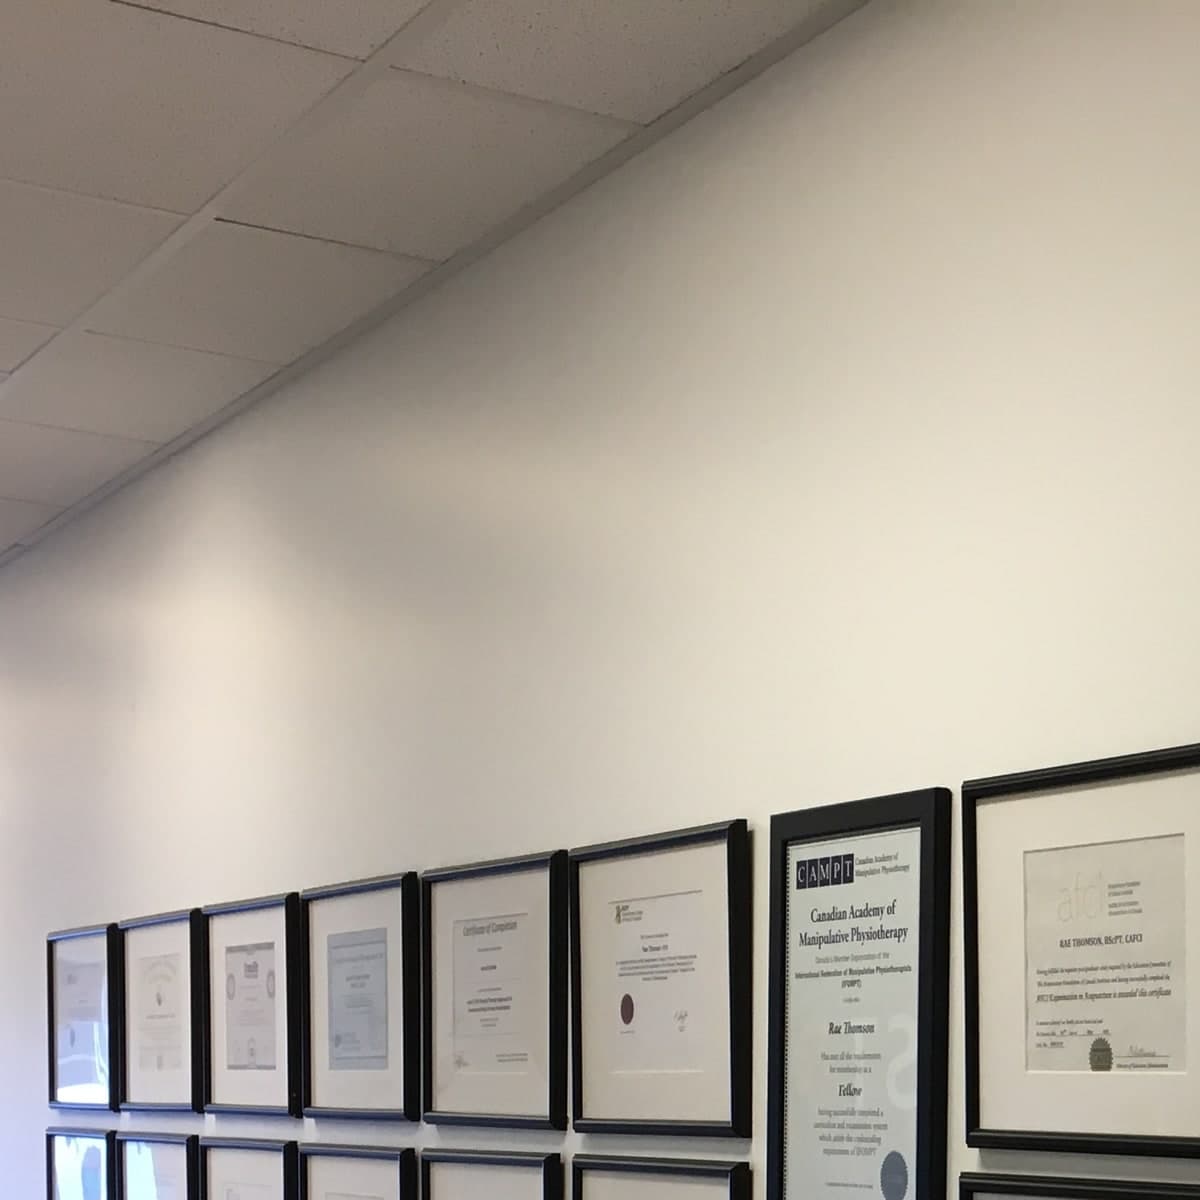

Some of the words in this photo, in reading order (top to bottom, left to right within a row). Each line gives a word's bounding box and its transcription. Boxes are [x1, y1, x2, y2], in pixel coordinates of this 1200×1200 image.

[798, 859, 852, 884] CAMPT
[811, 906, 847, 923] Canadian
[849, 903, 885, 919] Academy
[887, 899, 896, 915] of
[799, 929, 849, 949] Manipulative
[851, 924, 908, 945] Physiotherapy
[829, 1022, 842, 1034] Rae
[844, 1021, 874, 1034] Thomson
[839, 1083, 862, 1096] Fellow
